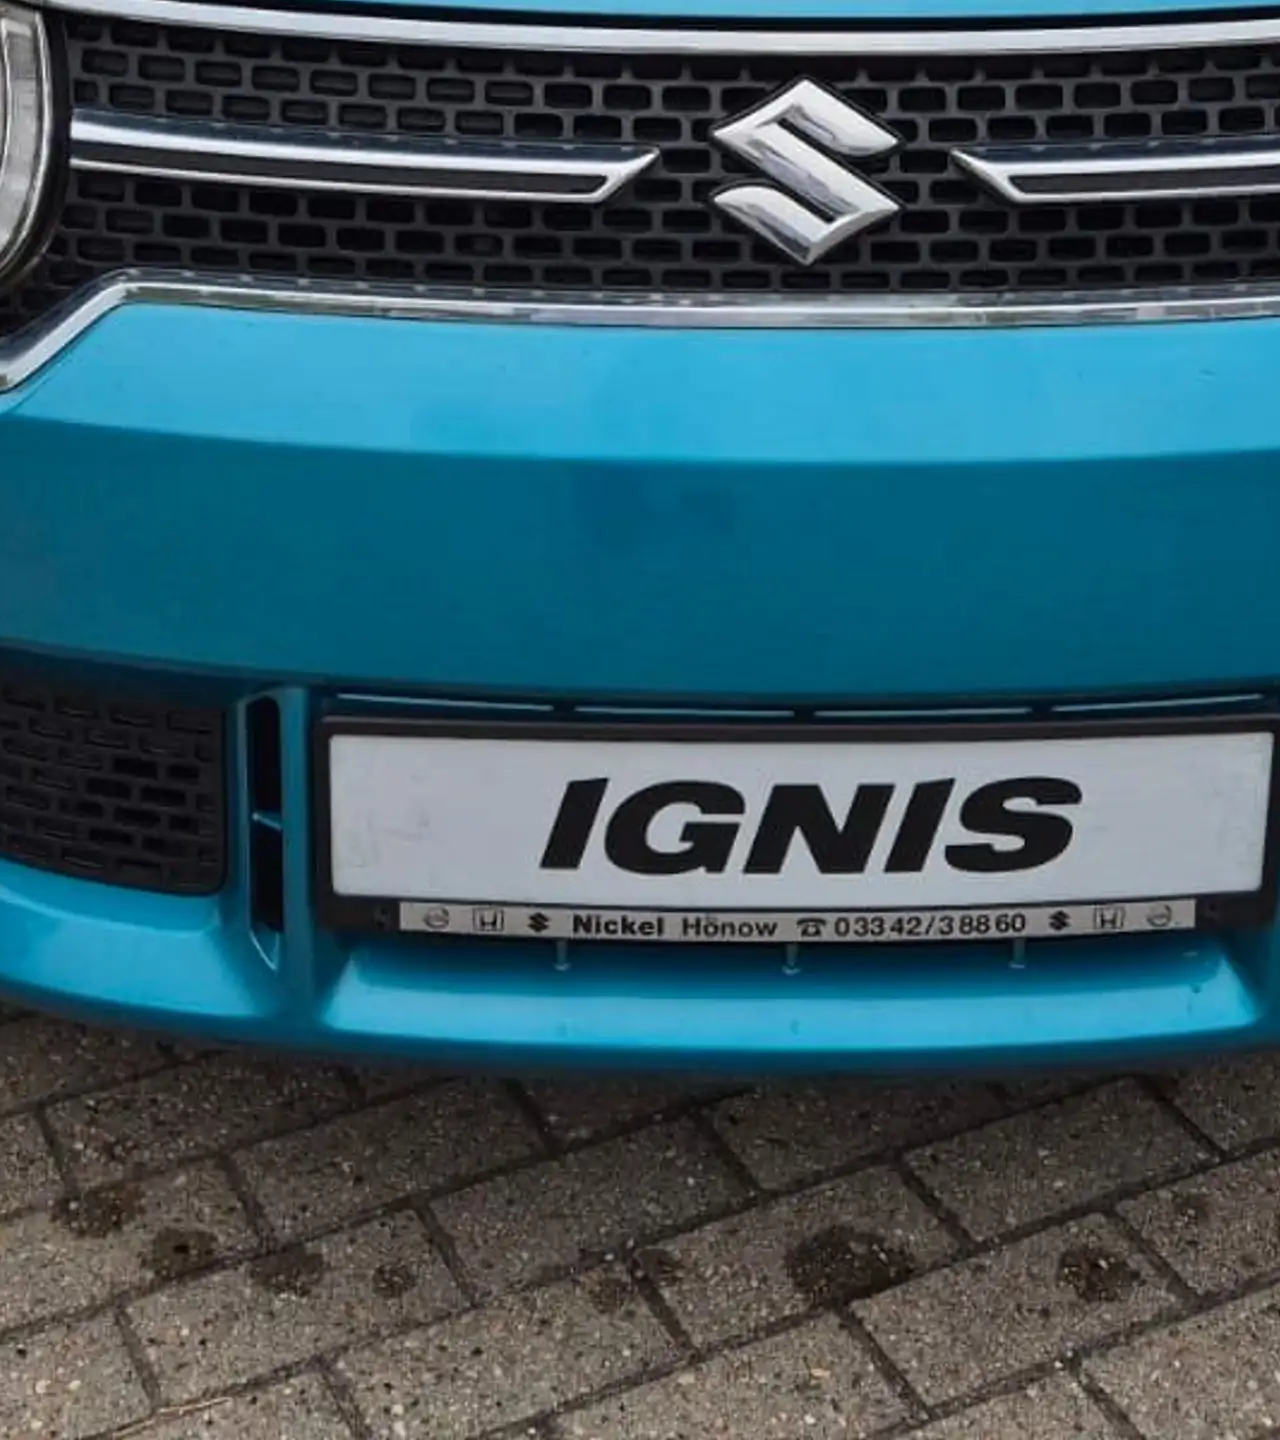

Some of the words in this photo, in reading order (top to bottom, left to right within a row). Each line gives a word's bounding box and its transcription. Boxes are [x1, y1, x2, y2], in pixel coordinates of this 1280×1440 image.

[540, 777, 1083, 875] IGNIS
[572, 913, 663, 937] Nickel
[682, 913, 778, 937] Hönow
